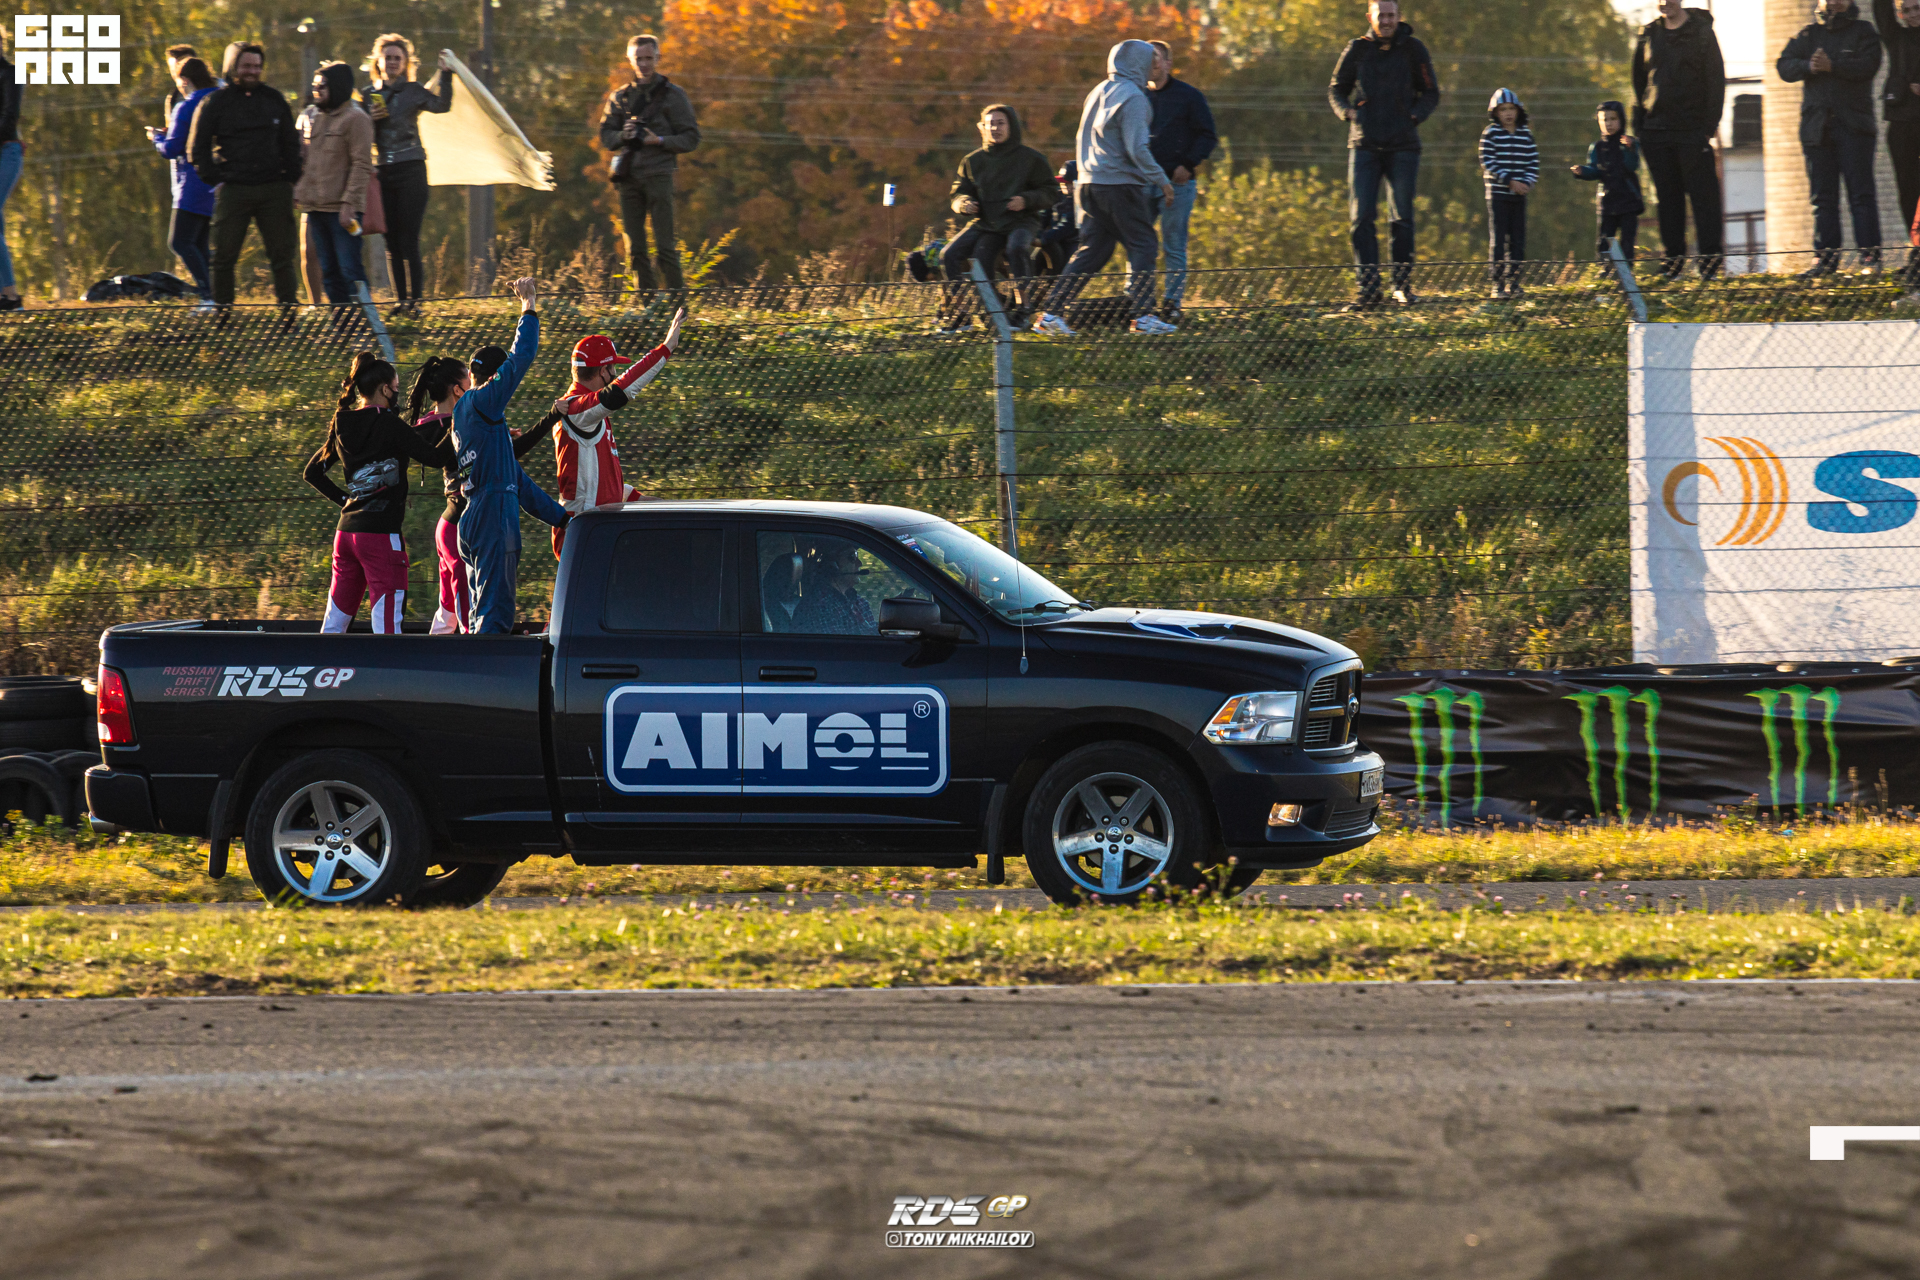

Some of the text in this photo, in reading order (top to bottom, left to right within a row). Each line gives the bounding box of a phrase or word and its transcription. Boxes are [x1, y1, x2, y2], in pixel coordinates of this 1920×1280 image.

[163, 666, 217, 675] RUSSIAN
[175, 677, 212, 686] DRIFT
[217, 666, 355, 697] RDS GP
[164, 688, 206, 696] SERIES
